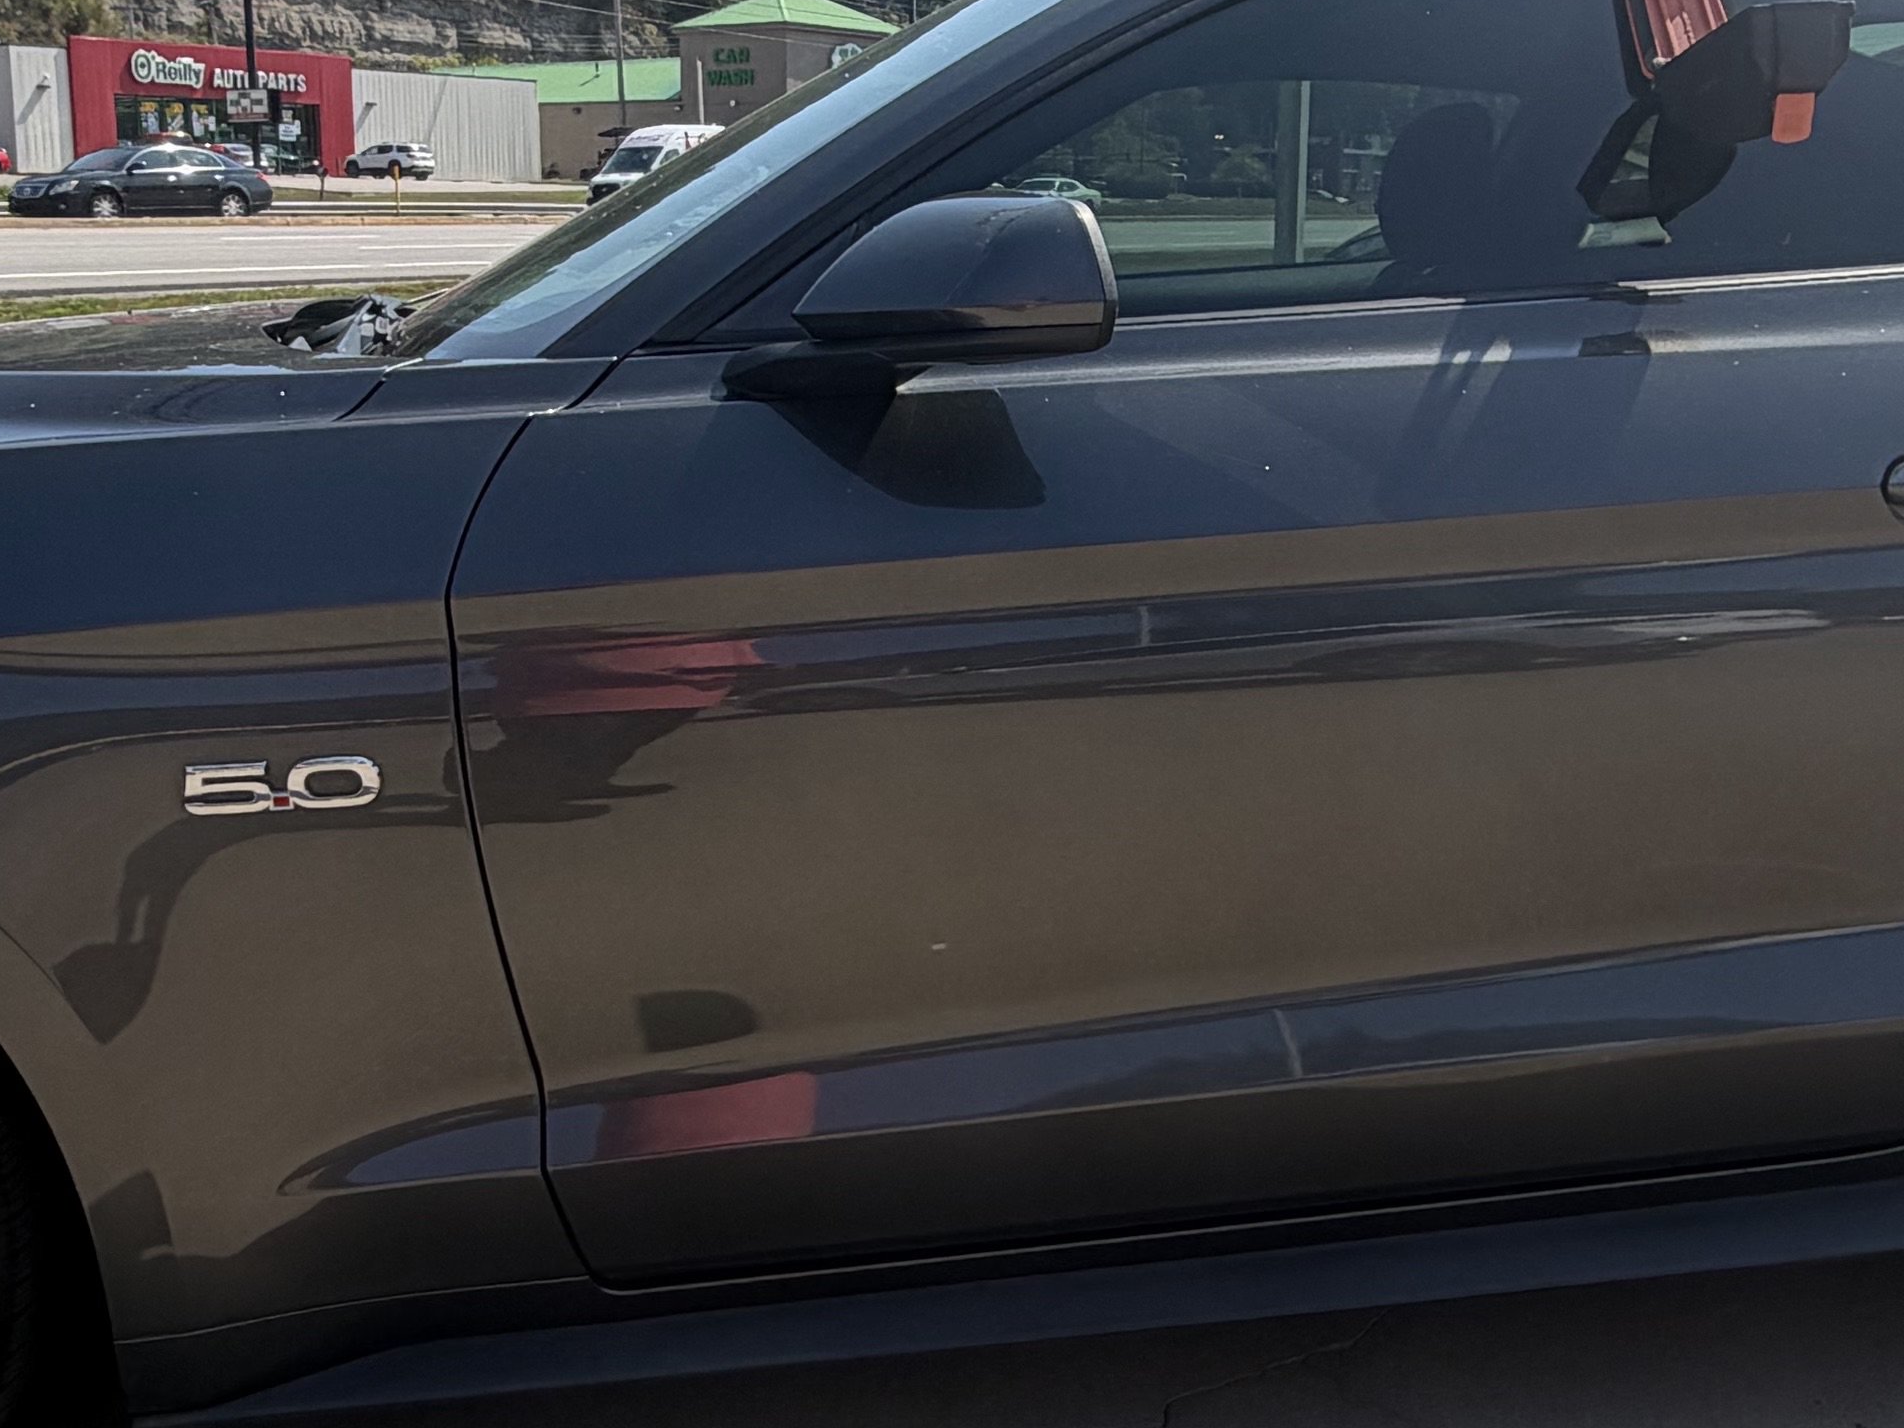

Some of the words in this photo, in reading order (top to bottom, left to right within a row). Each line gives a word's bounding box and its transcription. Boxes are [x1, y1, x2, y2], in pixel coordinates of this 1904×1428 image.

[132, 49, 205, 89] O'Reilly
[257, 70, 307, 92] PARTS
[713, 47, 750, 64] CAR
[707, 69, 754, 86] WASH
[184, 756, 382, 816] 5.0
